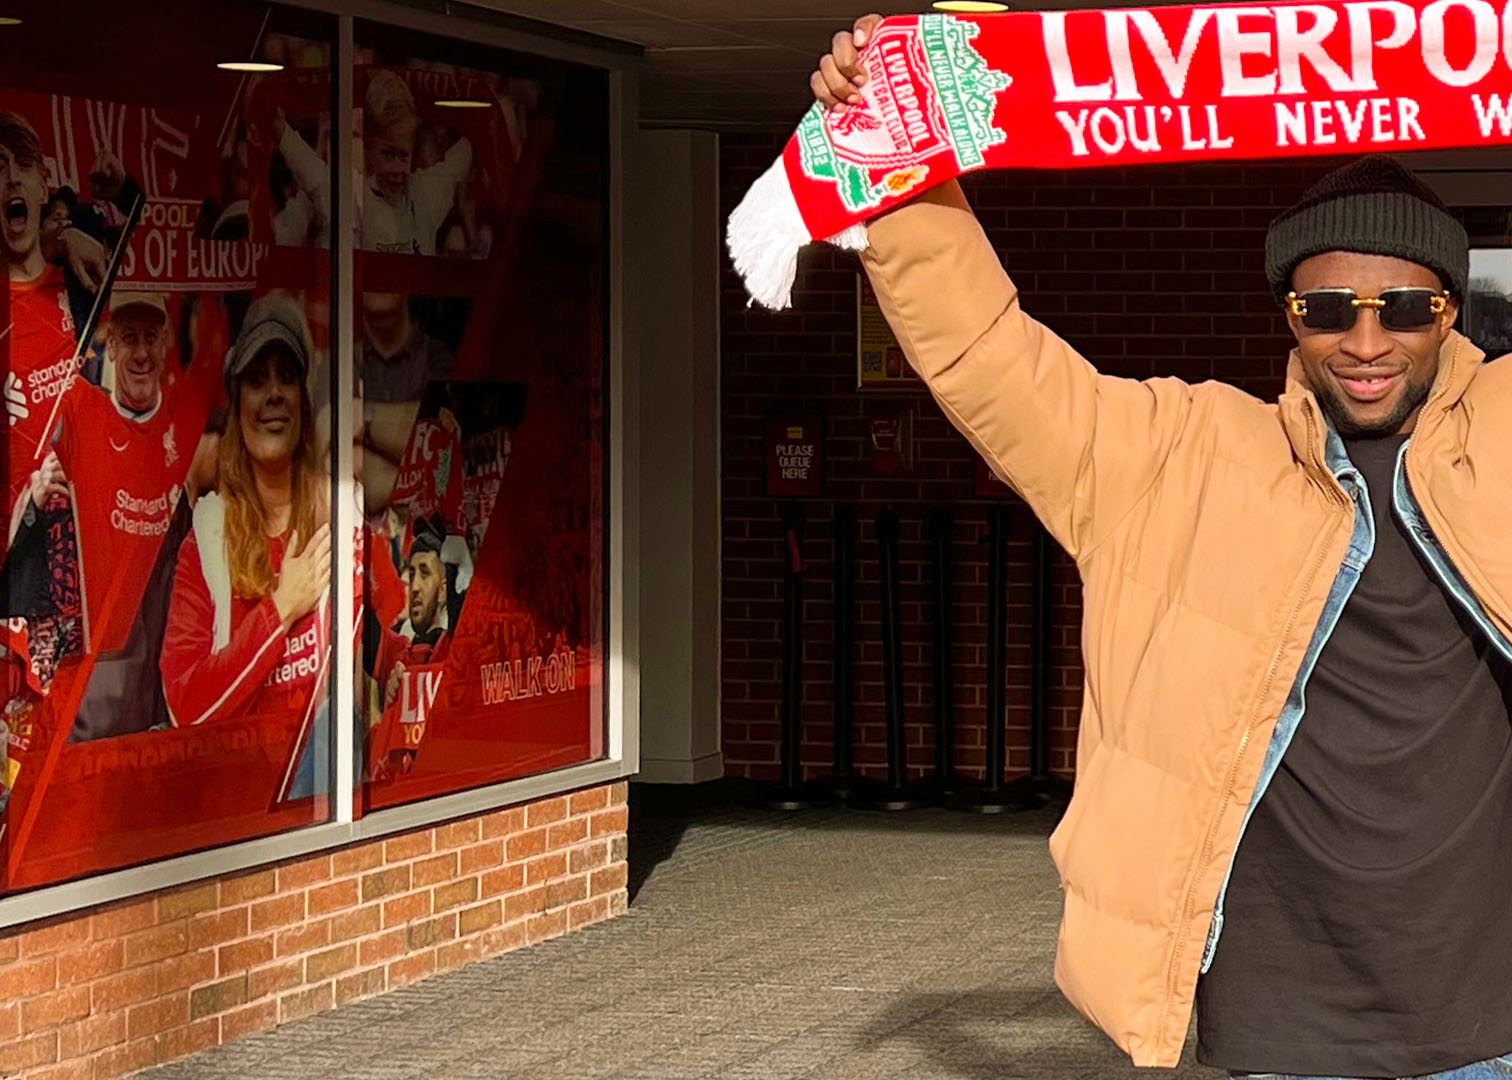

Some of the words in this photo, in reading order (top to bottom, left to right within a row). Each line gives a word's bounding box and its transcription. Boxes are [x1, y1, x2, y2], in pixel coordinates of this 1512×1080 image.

[868, 53, 894, 120] FOOTBALL
[881, 40, 930, 148] LIVERPOOL
[931, 50, 952, 94] NEVER
[941, 93, 963, 129] WALK
[1055, 104, 1234, 156] YOU'LL
[1274, 97, 1426, 147] NEVER
[952, 125, 979, 166] ALONE
[144, 228, 178, 278] OF
[776, 444, 814, 458] PLEASE
[779, 457, 811, 469] QUEUE
[782, 468, 808, 480] HERE
[480, 656, 543, 705] WALK
[545, 651, 576, 694] ON
